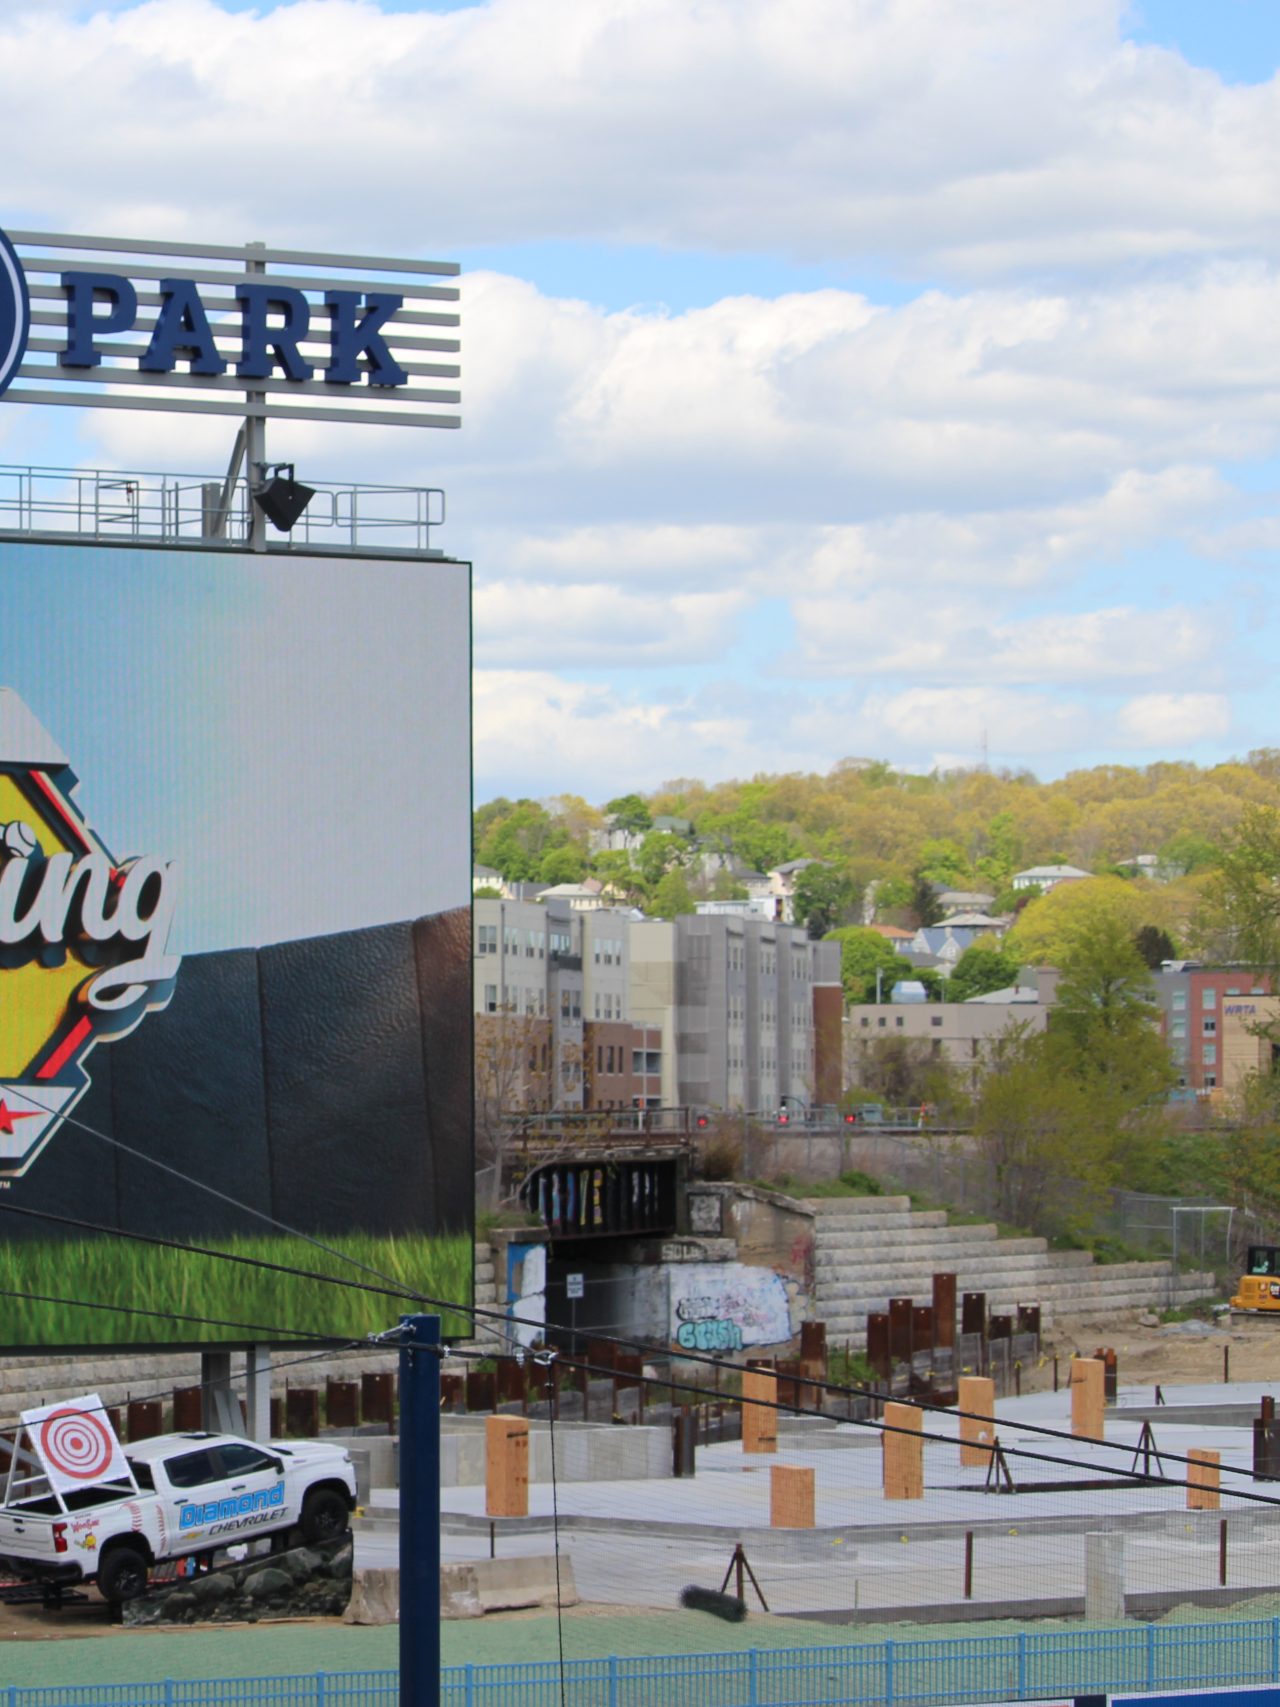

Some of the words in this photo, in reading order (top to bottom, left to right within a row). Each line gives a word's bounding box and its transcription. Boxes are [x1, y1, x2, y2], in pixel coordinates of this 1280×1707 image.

[60, 271, 408, 386] PARK
[179, 1480, 285, 1531] Diamond
[209, 1507, 288, 1535] CHEVROLET
